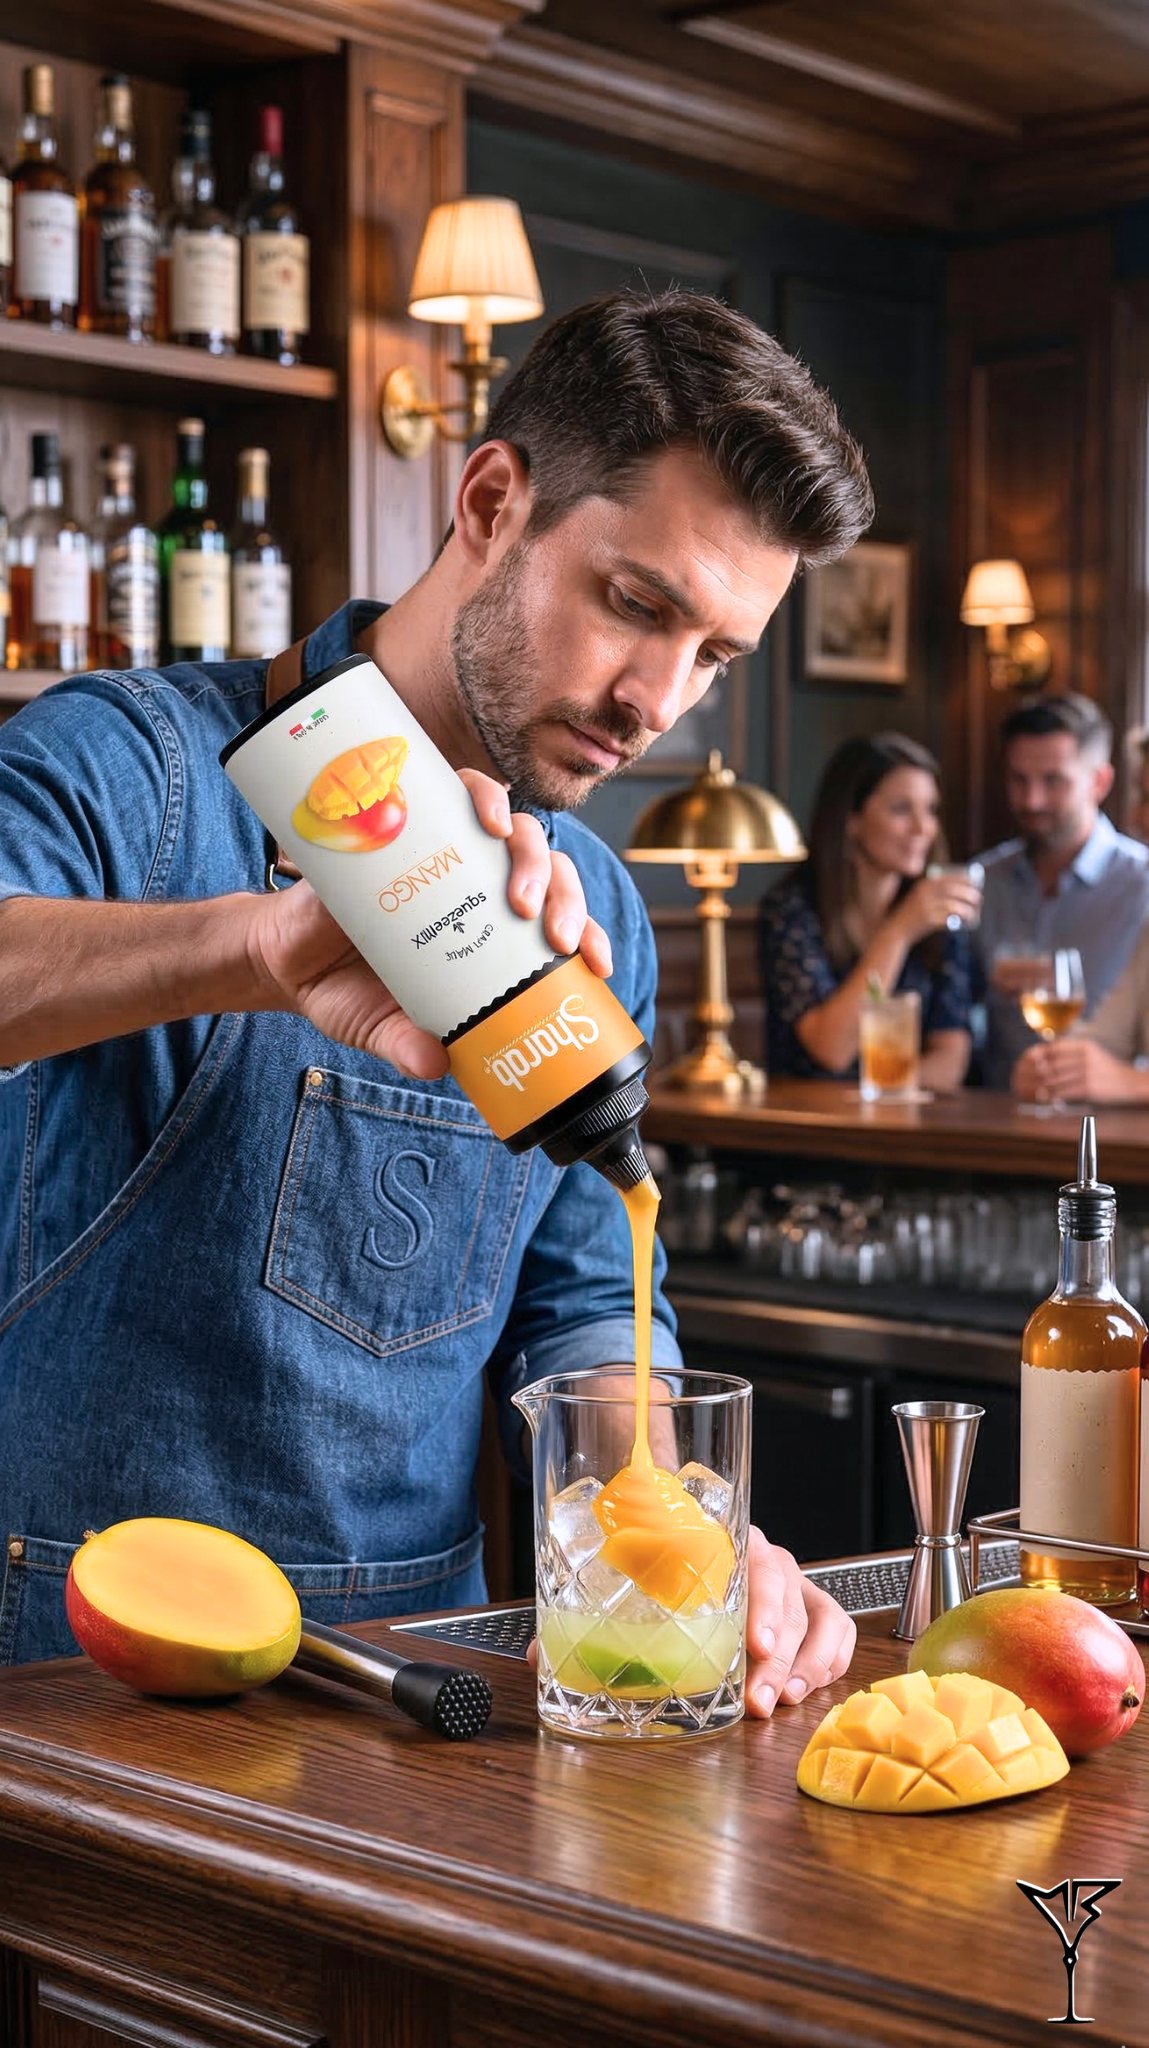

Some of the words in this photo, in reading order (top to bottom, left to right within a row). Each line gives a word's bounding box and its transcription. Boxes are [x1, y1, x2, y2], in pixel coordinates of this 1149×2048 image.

[379, 846, 464, 913] MANGO
[491, 994, 600, 1092] Sharab
[361, 1150, 436, 1271] S
